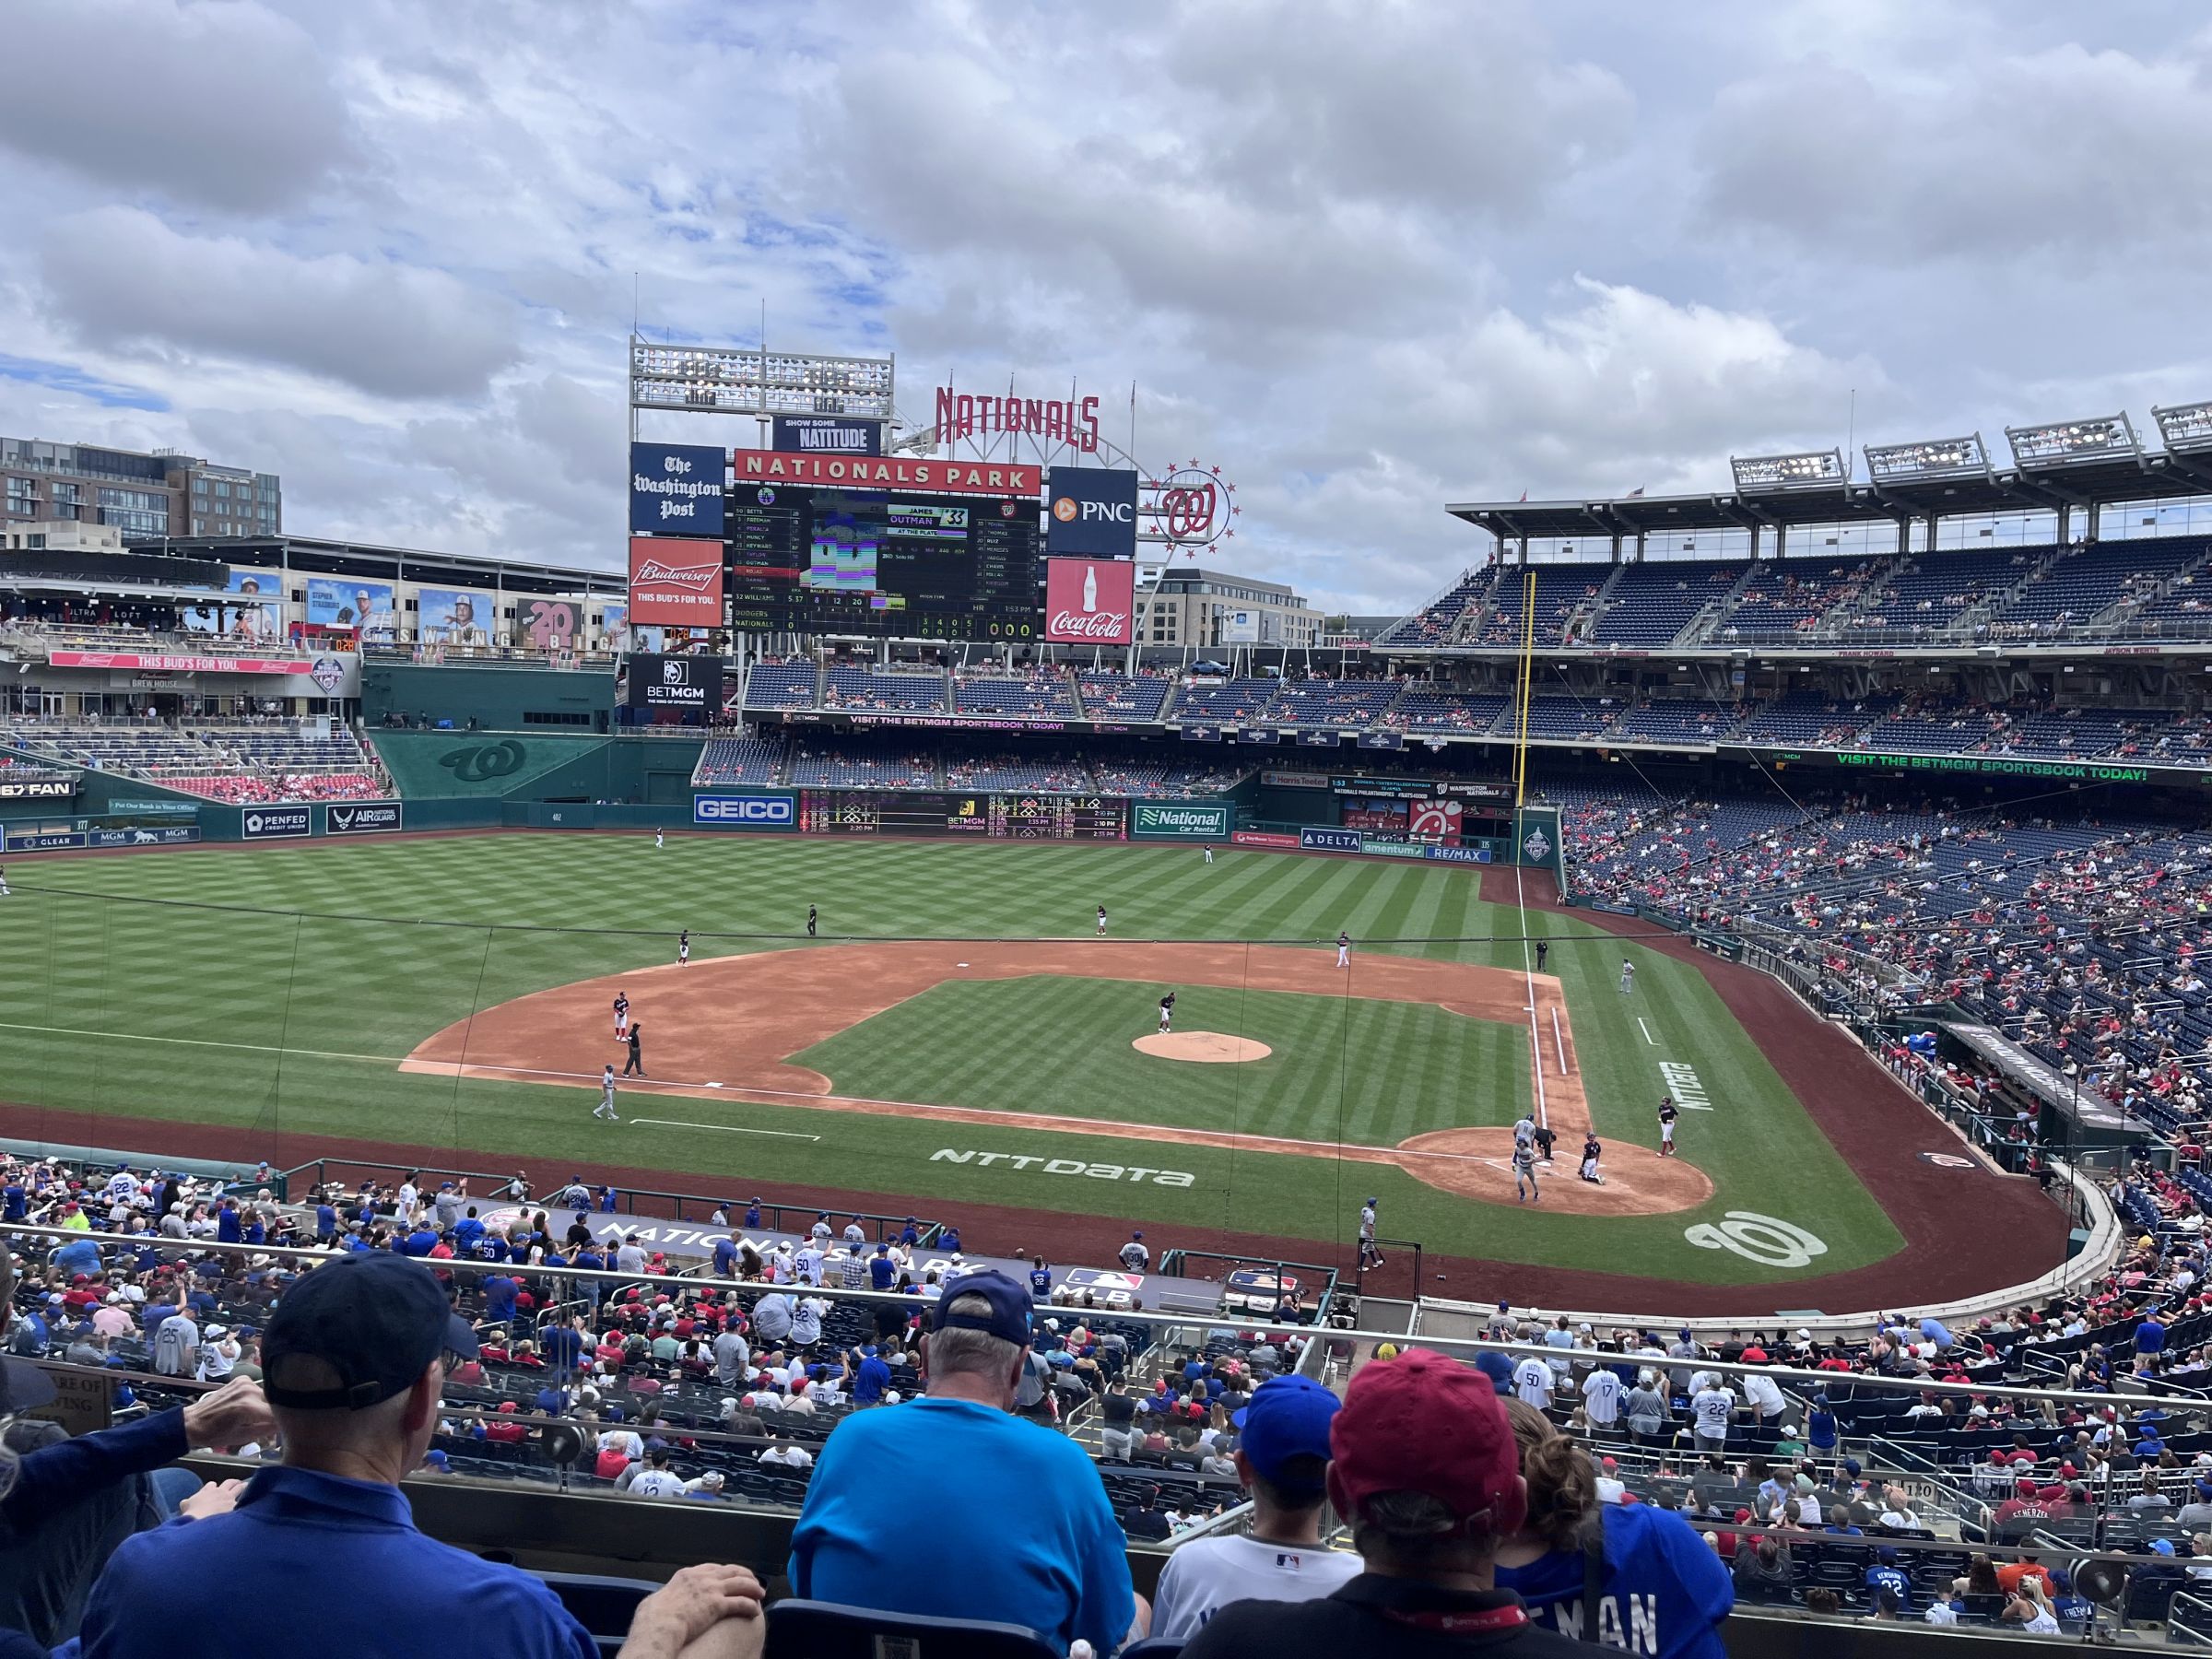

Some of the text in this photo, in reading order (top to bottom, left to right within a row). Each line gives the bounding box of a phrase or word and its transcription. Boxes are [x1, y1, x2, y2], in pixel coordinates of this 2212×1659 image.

[935, 386, 1099, 453] NATIONALS
[800, 428, 867, 449] NATITUDE
[665, 455, 691, 475] The
[747, 456, 1025, 488] NATIONALS PARK
[633, 473, 722, 498] Washington
[660, 500, 695, 520] Post
[1080, 500, 1132, 523] PNC
[890, 516, 933, 525] OUTMAN
[639, 564, 712, 582] Budweiser
[637, 593, 715, 605] THIS BUD'S FOR YOU.
[735, 609, 768, 618] DODGERS
[735, 619, 773, 628] NATIONALS
[1050, 610, 1127, 639] Coca-Cola
[989, 623, 1030, 637] 0 0 0
[138, 655, 240, 671] THIS BUD'S FOR YOU.
[132, 678, 178, 688] BREW HOUSE
[647, 687, 704, 699] BETMGM
[850, 715, 1064, 731] VISIT THE BETMGM SPORTSBOOK TODAY!
[1838, 754, 2147, 782] VISIT THE BETMGM SPORTSBOOK TODAY!
[1277, 776, 1327, 786] Harris Teeter
[1333, 779, 1346, 787] 1:53
[29, 783, 69, 795] FAN
[1335, 787, 1359, 795] NATIONALS
[1466, 789, 1500, 797] NATIONALS
[698, 799, 790, 818] GEICO
[265, 815, 306, 825] PENFED
[356, 809, 374, 823] AIR
[373, 813, 396, 821] GUARD
[552, 812, 561, 822] 402
[947, 817, 986, 826] BETMGM
[76, 819, 88, 830] 377
[100, 829, 189, 841] MGM MGM
[1316, 834, 1359, 847] DELTA
[41, 837, 70, 846] CLEAR
[1481, 841, 1490, 849] 335
[1365, 843, 1414, 855] amentum
[1434, 848, 1480, 861] RE/MAX
[114, 1182, 129, 1194] 22
[483, 1247, 495, 1259] 50
[1129, 1253, 1140, 1263] 30
[796, 1258, 809, 1271] 50
[1035, 1277, 1044, 1286] 22
[1053, 1283, 1132, 1303] MLB
[794, 1309, 808, 1322] 22
[163, 1327, 179, 1344] 25
[1526, 1372, 1539, 1387] 50
[1600, 1375, 1615, 1383] KELLY
[81, 1379, 101, 1393] OF
[662, 1382, 679, 1392] DANIELS
[1601, 1384, 1613, 1398] 17
[1709, 1403, 1726, 1416] 22
[1907, 1484, 1932, 1498] 120
[1877, 1572, 1901, 1581] KERSHAW
